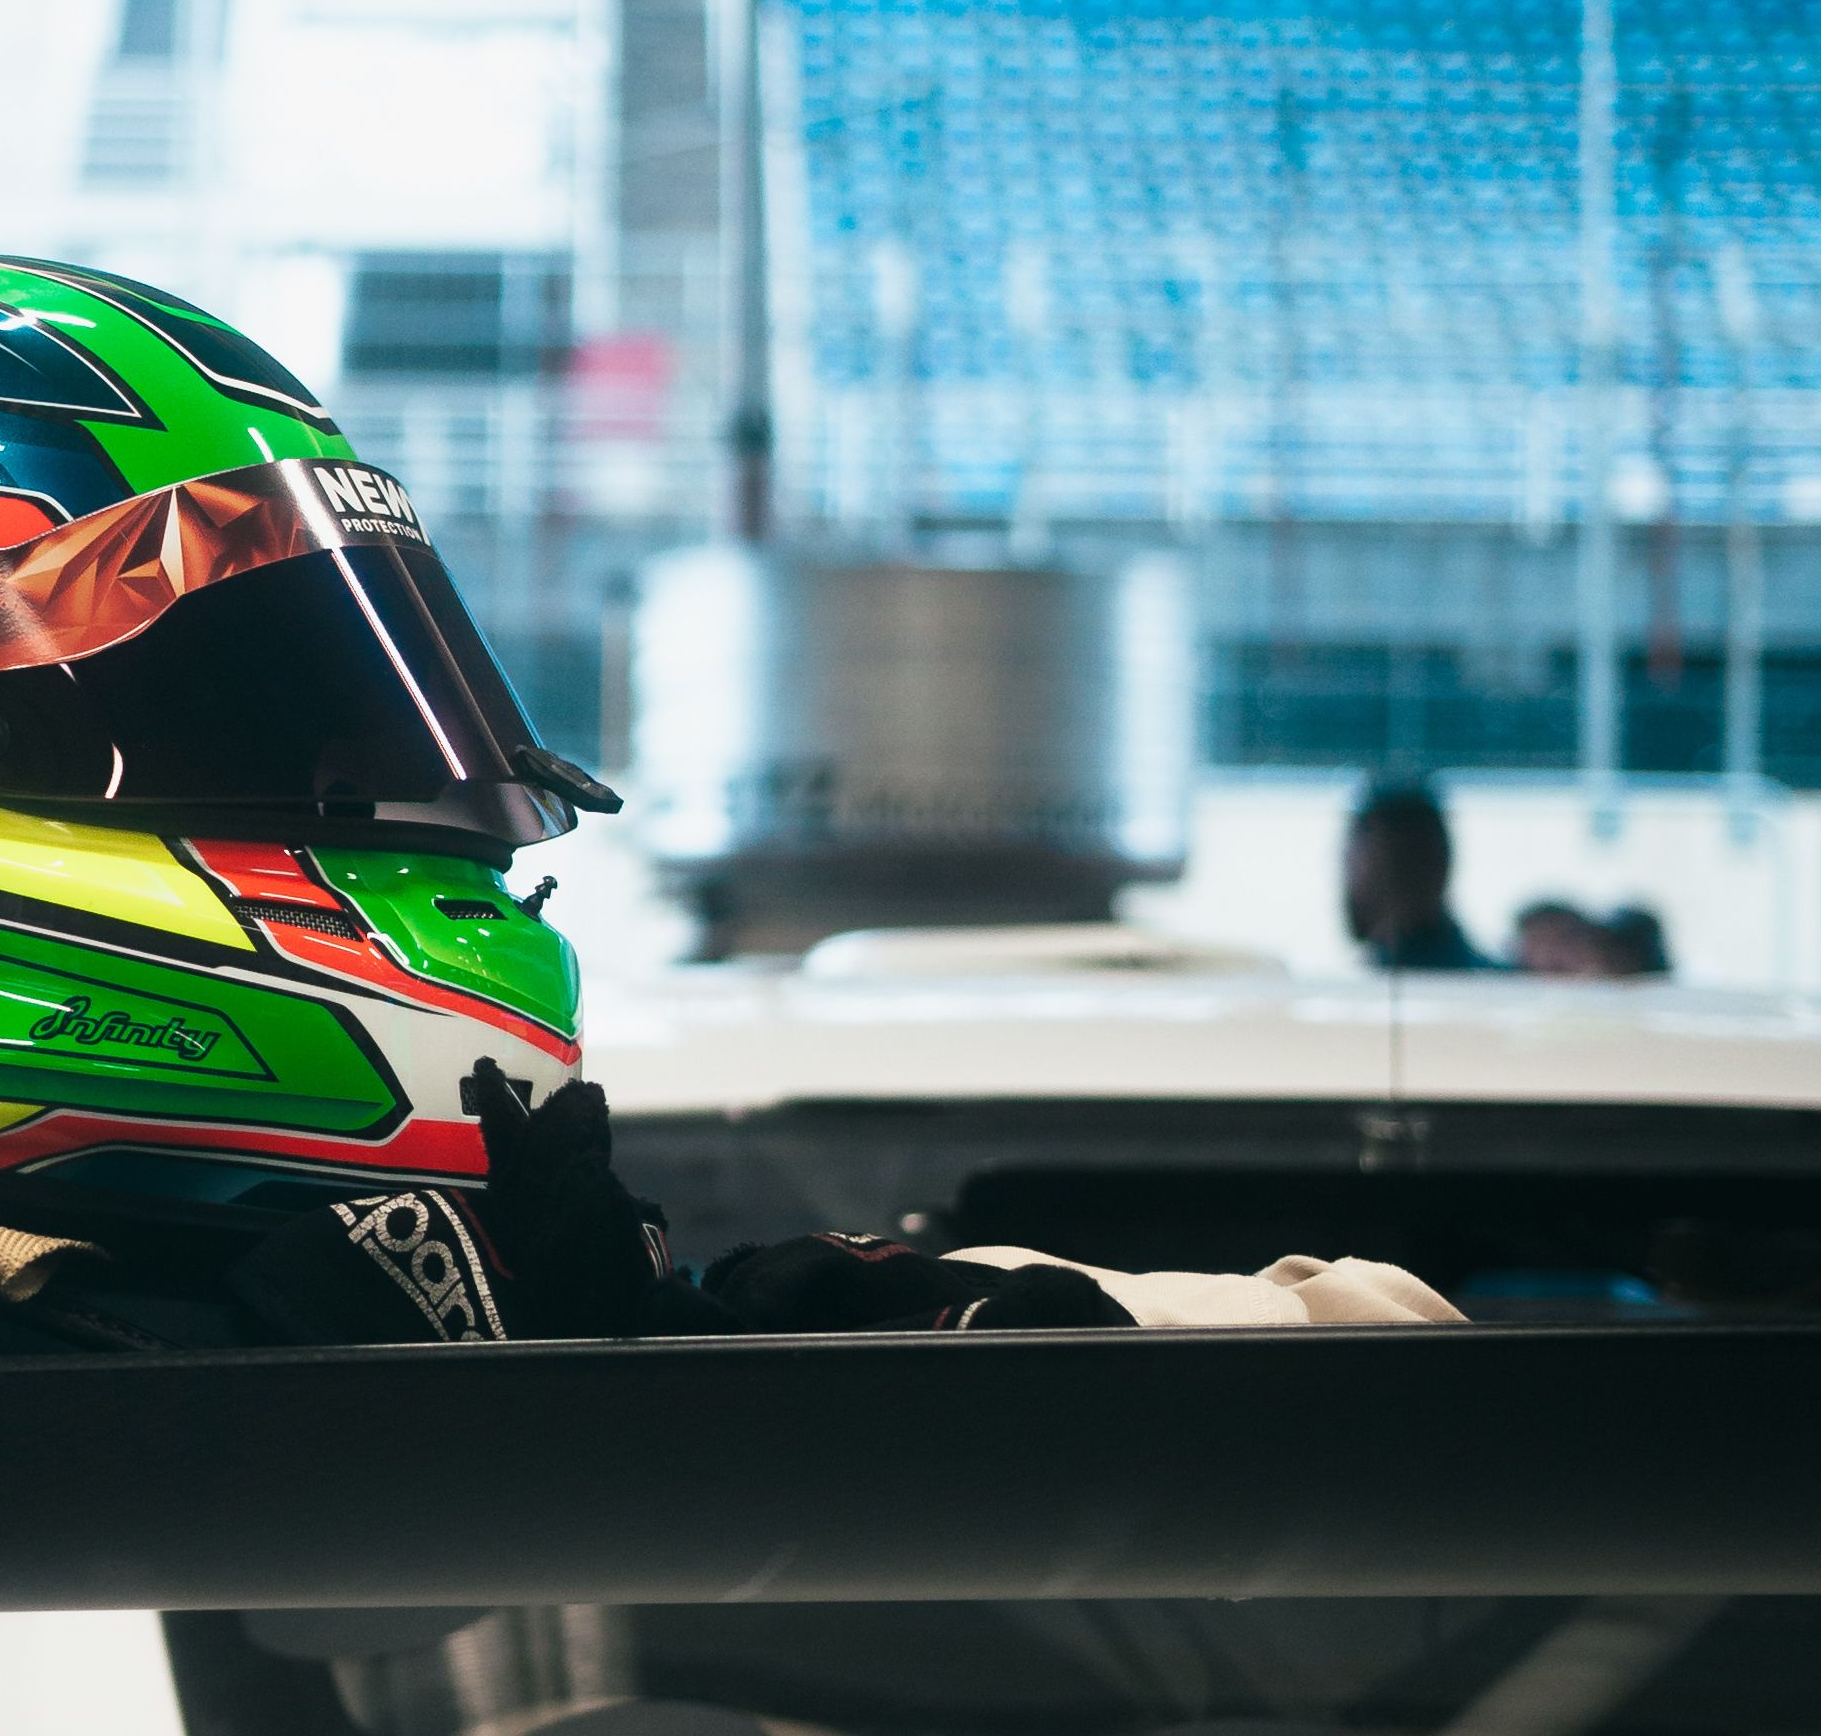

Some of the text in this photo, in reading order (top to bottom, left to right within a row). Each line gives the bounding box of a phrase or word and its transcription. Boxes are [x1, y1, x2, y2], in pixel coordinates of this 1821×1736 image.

[313, 467, 431, 547] NEW
[341, 518, 423, 543] PROTECTION
[29, 995, 221, 1061] Infinity
[348, 1192, 484, 1341] par
